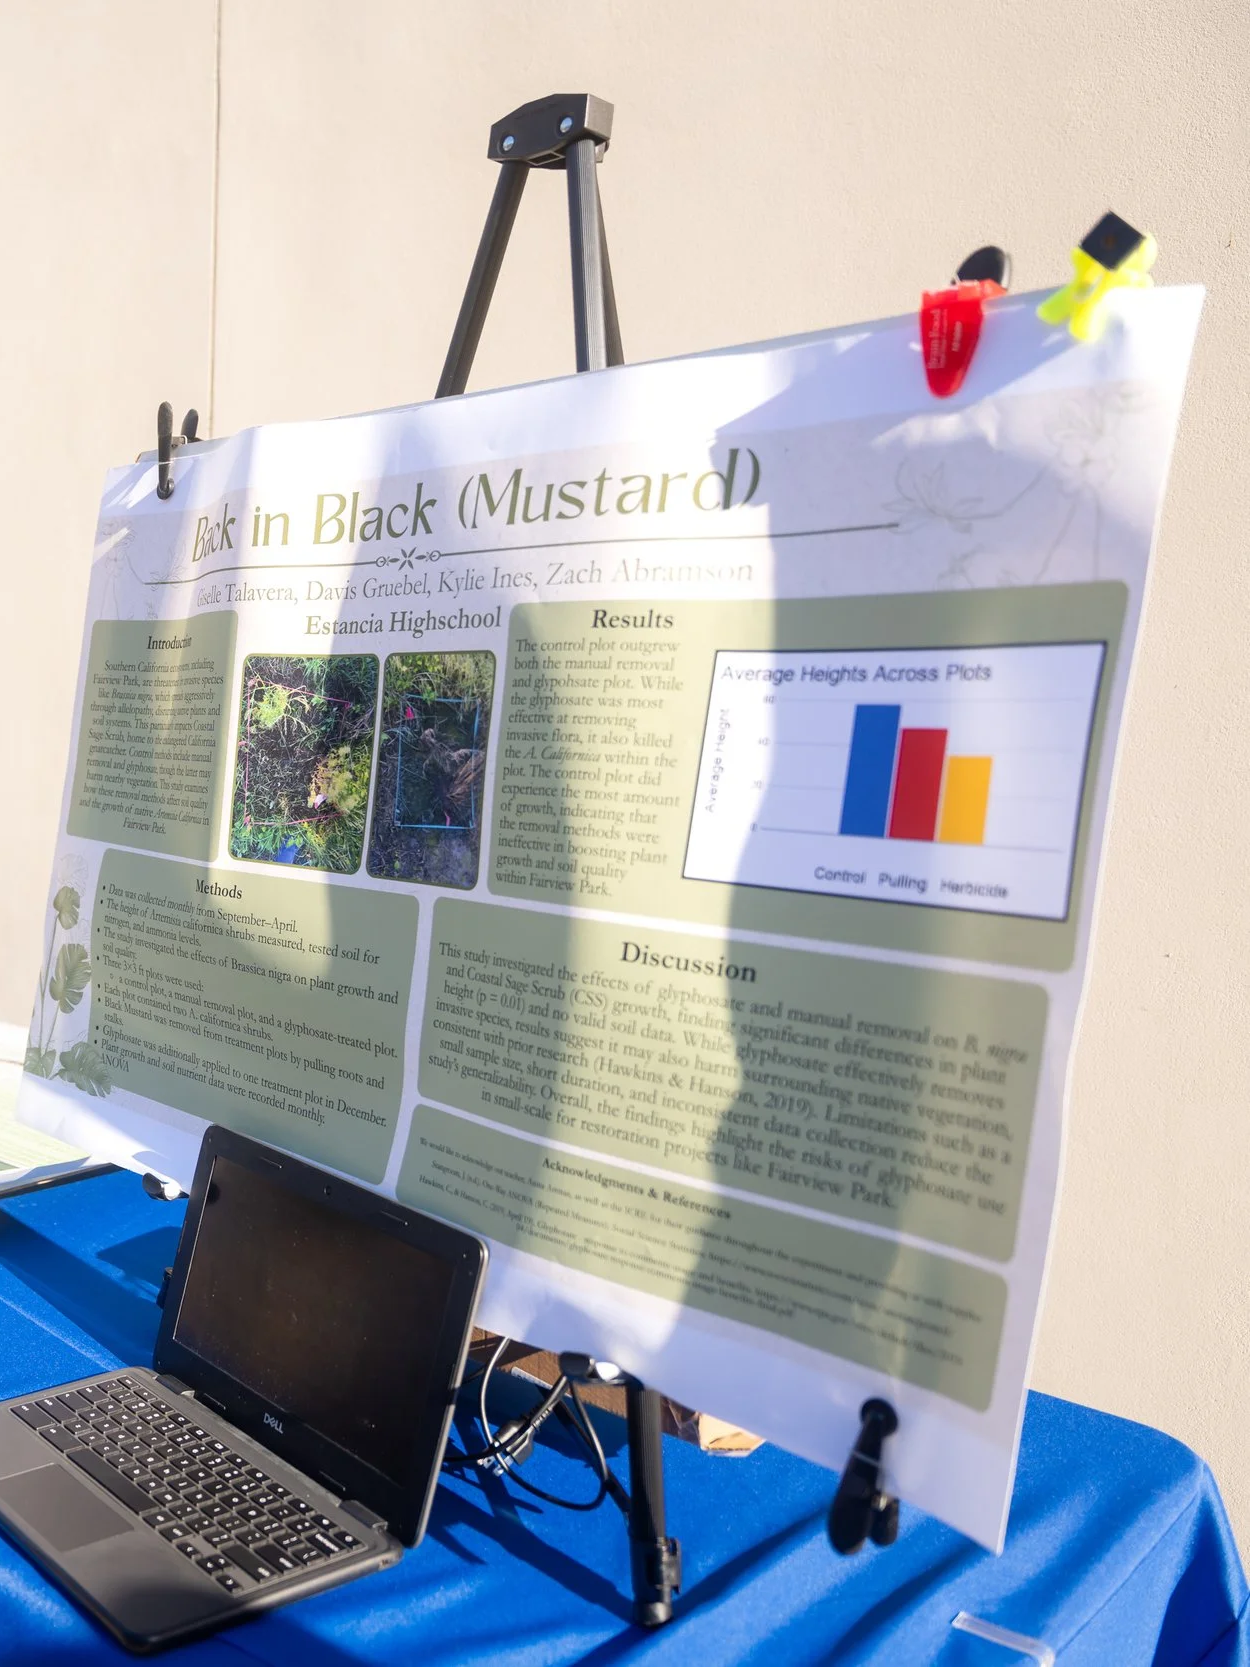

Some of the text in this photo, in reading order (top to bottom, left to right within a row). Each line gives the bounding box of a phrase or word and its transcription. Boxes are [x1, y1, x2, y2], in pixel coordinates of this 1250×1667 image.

[192, 448, 760, 562] Back in Black (Mustard)
[225, 582, 298, 605] Talavera,
[307, 579, 356, 601] Davis
[363, 572, 431, 599] Gruebel,
[438, 568, 484, 599] Kylie
[492, 566, 537, 590] Ines,
[546, 560, 602, 586] Zach
[611, 558, 752, 582] Abramson
[305, 606, 500, 638] Estancia Highschool
[592, 609, 674, 628] Results
[146, 635, 192, 649] Introduct
[516, 637, 679, 655] The control plot outgrew
[514, 656, 675, 671] both the manual removal
[721, 665, 992, 685] Average Heights Across Plots
[512, 676, 531, 688] and
[603, 676, 633, 694] plot.
[641, 676, 684, 691] While
[705, 709, 730, 813] Average Height
[123, 817, 166, 834] Fairview Park.
[500, 799, 657, 824] of growth, indicating that
[500, 817, 659, 844] the removal methods were
[498, 833, 667, 865] ineffective in boosting plant
[496, 853, 627, 880] growth and soil quality
[814, 866, 1008, 898] Control Pulling Herbicide
[196, 879, 242, 899] Methods
[495, 871, 612, 896] within Fairview Park.
[109, 884, 123, 896] Data
[125, 891, 136, 899] was
[138, 893, 166, 906] collected
[168, 898, 194, 914] monthly
[196, 904, 214, 918] from
[107, 898, 380, 964] The height of Artemisia californica shrubs measured, tested soil for
[103, 954, 121, 969] Three
[139, 965, 144, 976] ft
[146, 968, 163, 981] plots
[165, 974, 182, 986] were
[185, 979, 204, 992] used:
[104, 926, 398, 1004] The study investigated the effects of Brassica nigra on plant growth and
[621, 940, 756, 983] Discussion
[104, 1013, 123, 1026] stalks.
[124, 978, 148, 991] control
[150, 985, 166, 997] plot,
[175, 992, 201, 1006] manual
[204, 1000, 235, 1015] removal
[238, 1007, 256, 1023] plot,
[259, 1014, 274, 1026] and
[285, 1019, 371, 1051] glyphosate-treated
[374, 1043, 398, 1058] plot.
[105, 996, 384, 1090] Black Mustard was removed from treatment plots by pulling roots and
[101, 1038, 325, 1126] Plant growth and soil nutrient data were recorded monthly.
[440, 1038, 463, 1053] small
[466, 1047, 499, 1066] sample
[502, 1056, 523, 1074] size,
[527, 1062, 557, 1081] short
[561, 1071, 623, 1099] duration,
[629, 1088, 657, 1101] and
[662, 1091, 759, 1128] inconsistent
[764, 1115, 800, 1138] data
[806, 1127, 896, 1159] collection
[481, 1087, 898, 1208] in small-scale for restoration projects like Fairview Park.
[542, 1156, 731, 1220] Acknowledgments & References
[263, 1413, 283, 1434] DELL
